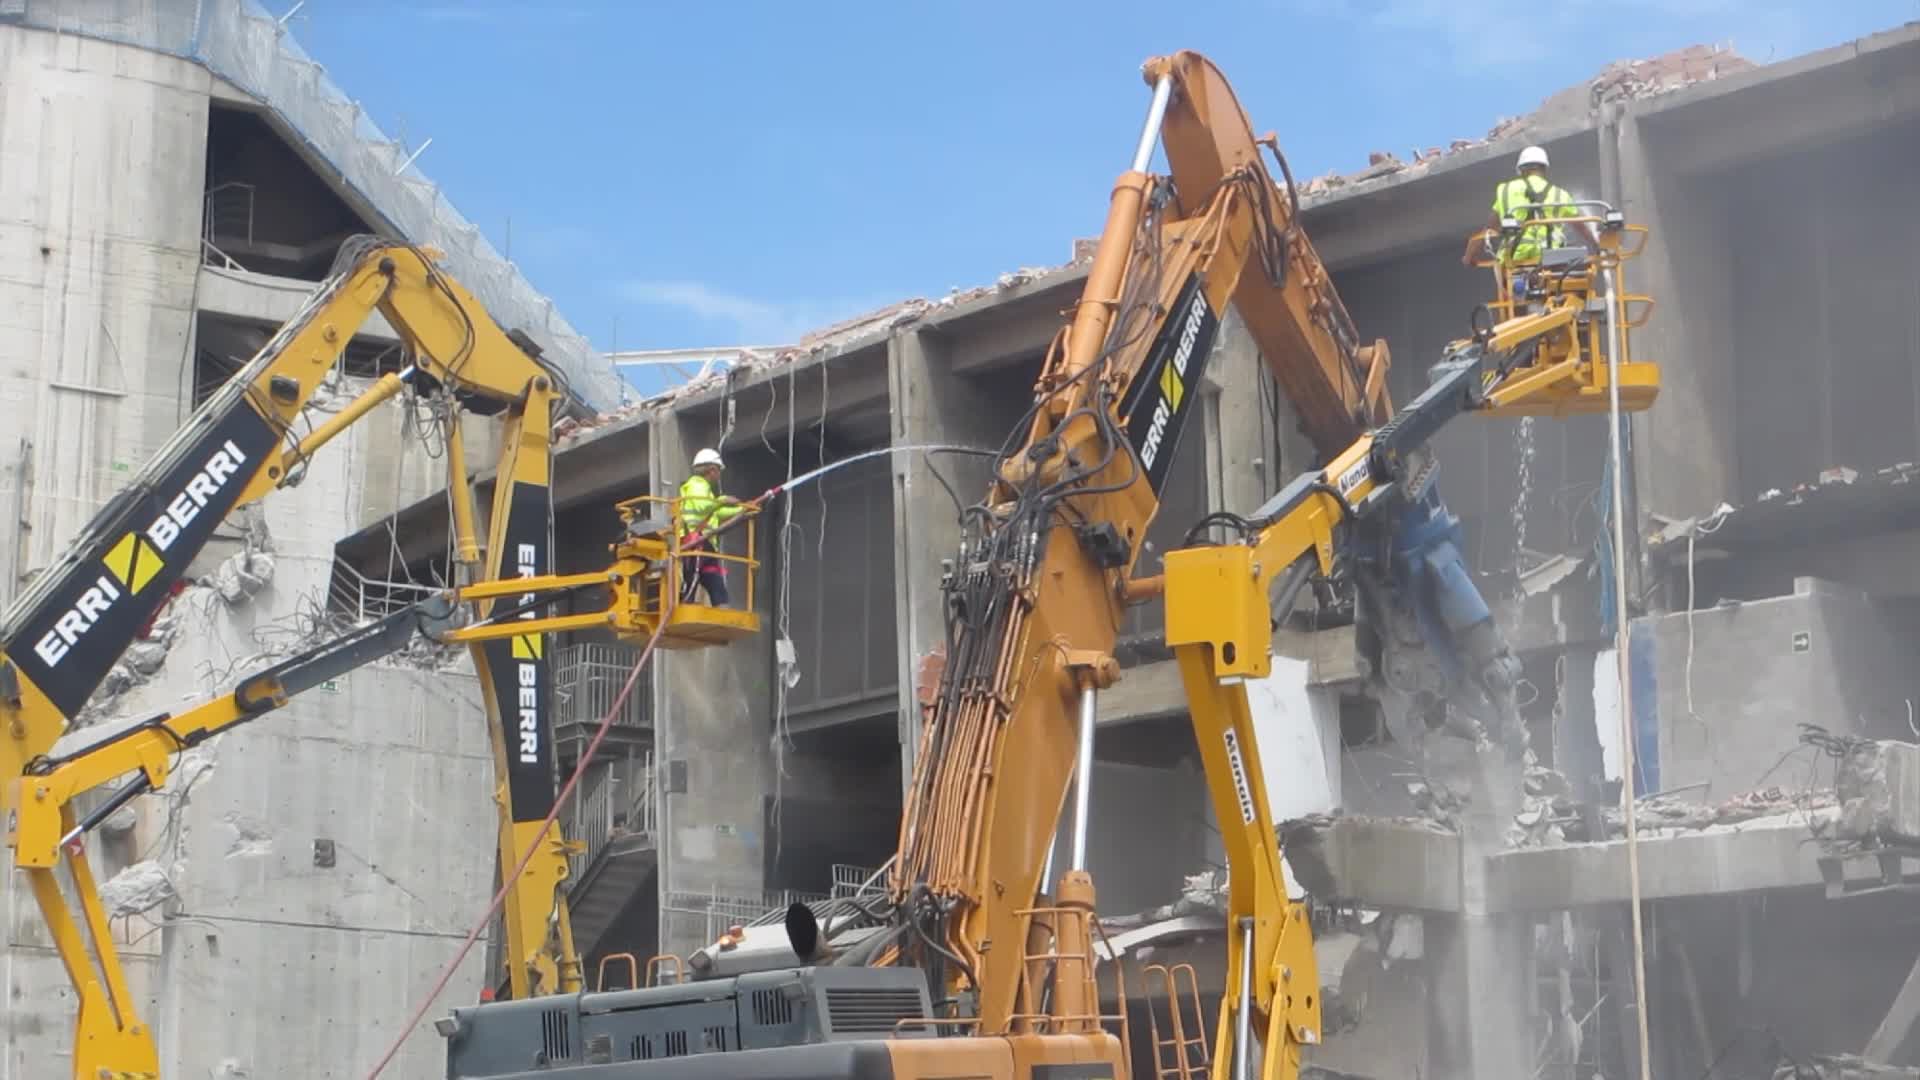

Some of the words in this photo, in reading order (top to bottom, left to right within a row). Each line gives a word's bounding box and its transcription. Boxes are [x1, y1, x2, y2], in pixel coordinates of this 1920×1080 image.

[1140, 398, 1171, 472] ERRI
[1173, 289, 1208, 376] BERRI
[34, 576, 120, 667] ERRI
[146, 439, 247, 551] BERRI
[518, 663, 538, 763] BERRI
